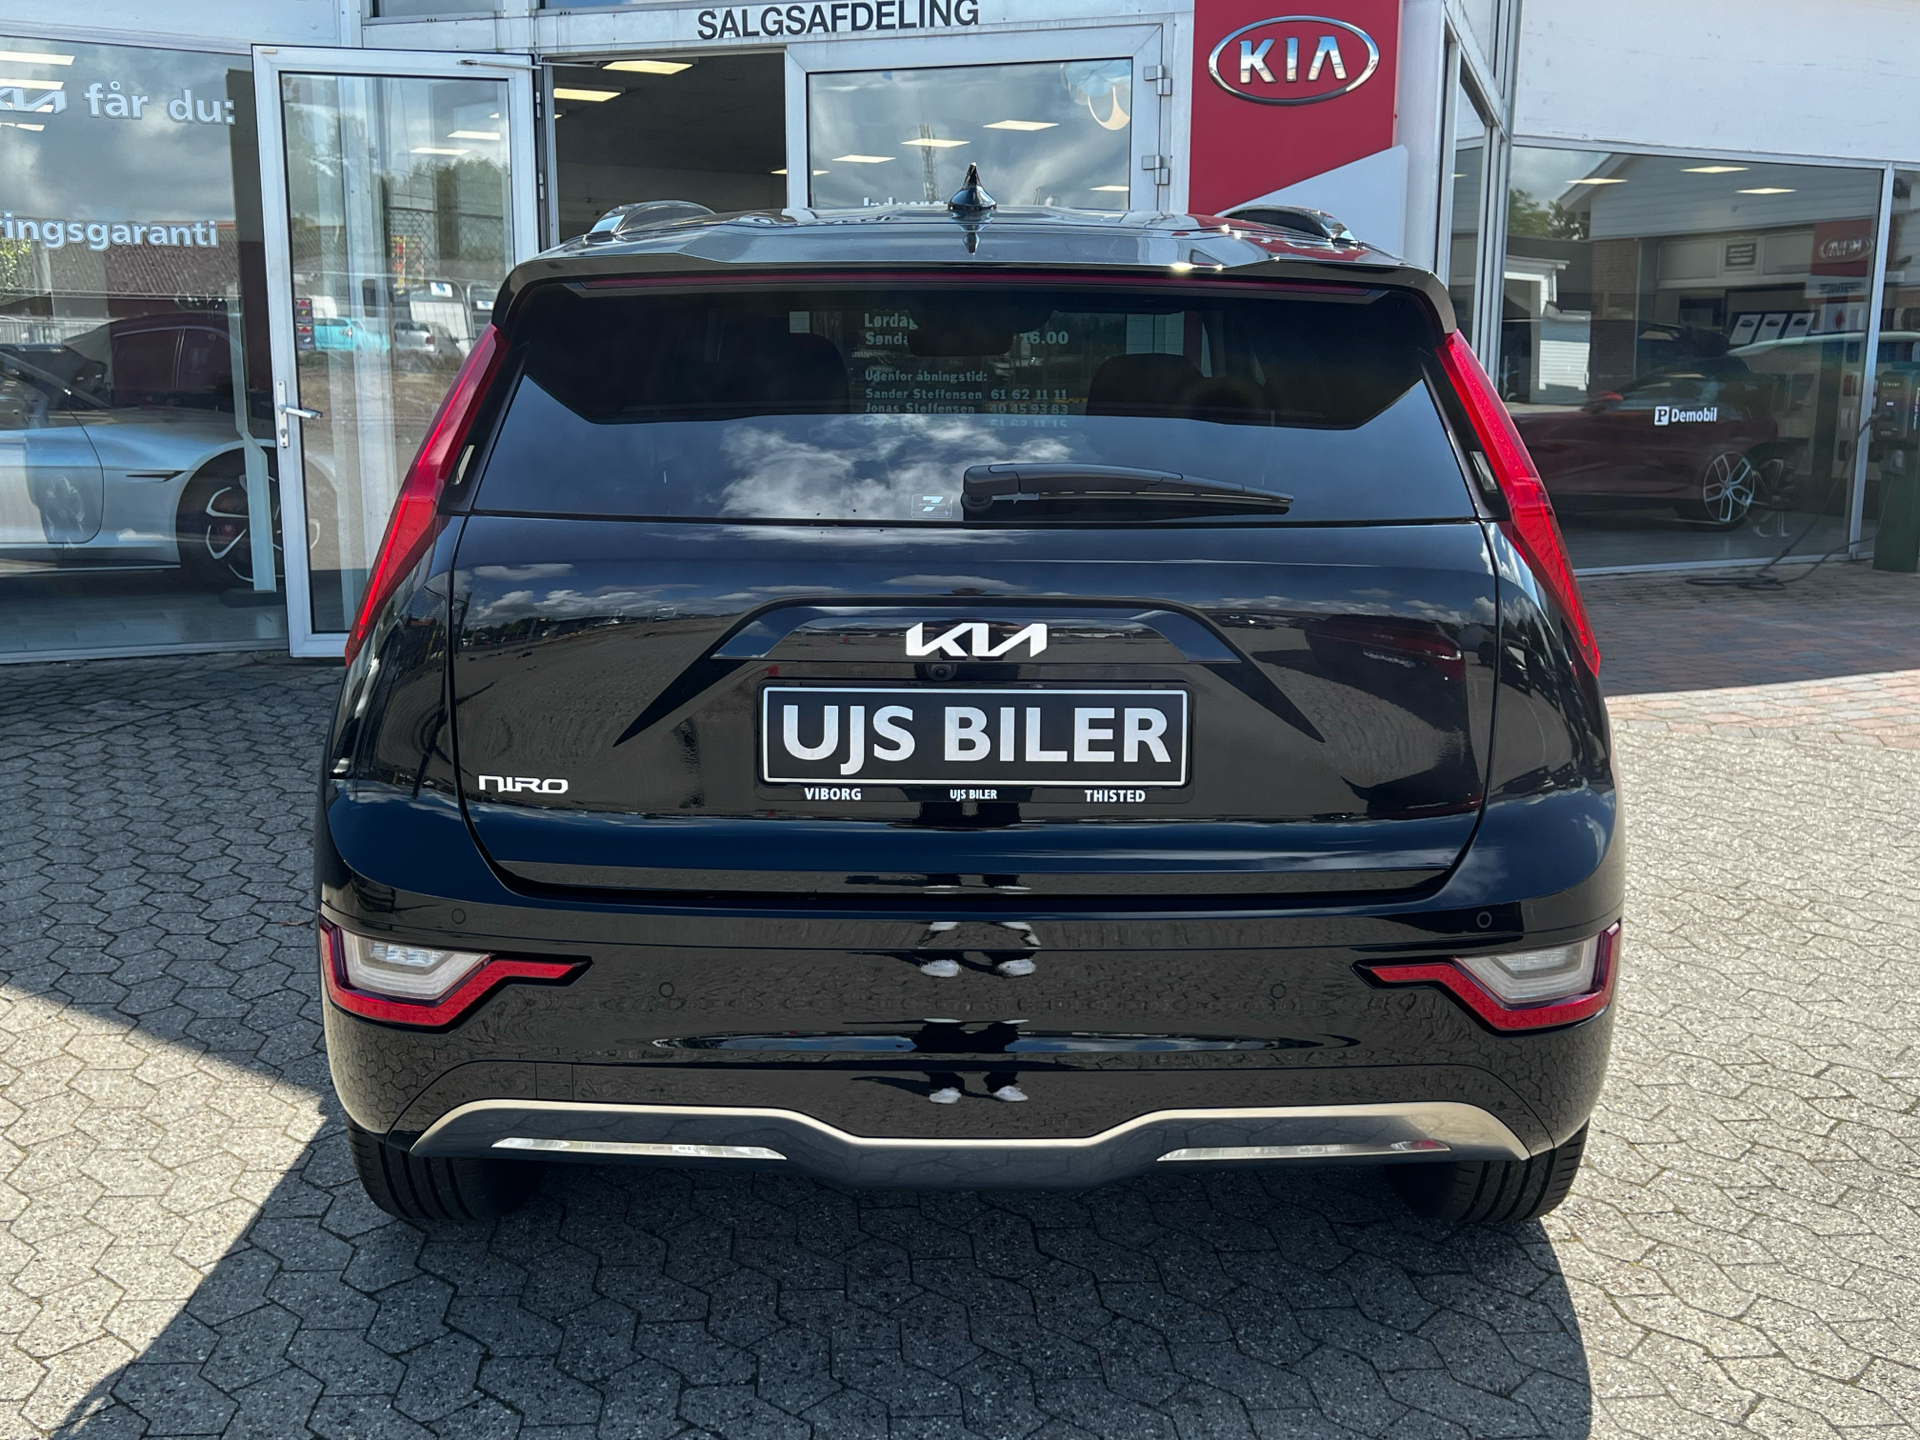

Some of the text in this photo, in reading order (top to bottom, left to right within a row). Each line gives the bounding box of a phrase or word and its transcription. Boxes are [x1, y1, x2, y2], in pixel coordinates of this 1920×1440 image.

[697, 0, 979, 39] SALGSAFDELING
[1239, 36, 1348, 84] KIA
[84, 80, 149, 118] får
[168, 88, 235, 125] du:
[0, 211, 219, 251] ingsgaranti
[865, 370, 987, 384] Udenfor åbningstid:
[865, 388, 1068, 400] Sander Steffensen 61 62 11 11
[865, 402, 900, 413] Jonas
[905, 402, 975, 413] Steffensen
[1010, 404, 1027, 414] 45
[1030, 404, 1047, 414] 93
[1051, 404, 1068, 414] 83
[1671, 406, 1717, 422] Demobil
[906, 622, 1048, 657] KIA
[782, 704, 1172, 775] UJS BILER
[479, 775, 568, 794] NIRO
[804, 788, 862, 801] VIBORG
[949, 788, 998, 800] UJS BILER
[1084, 790, 1146, 802] THISTED
